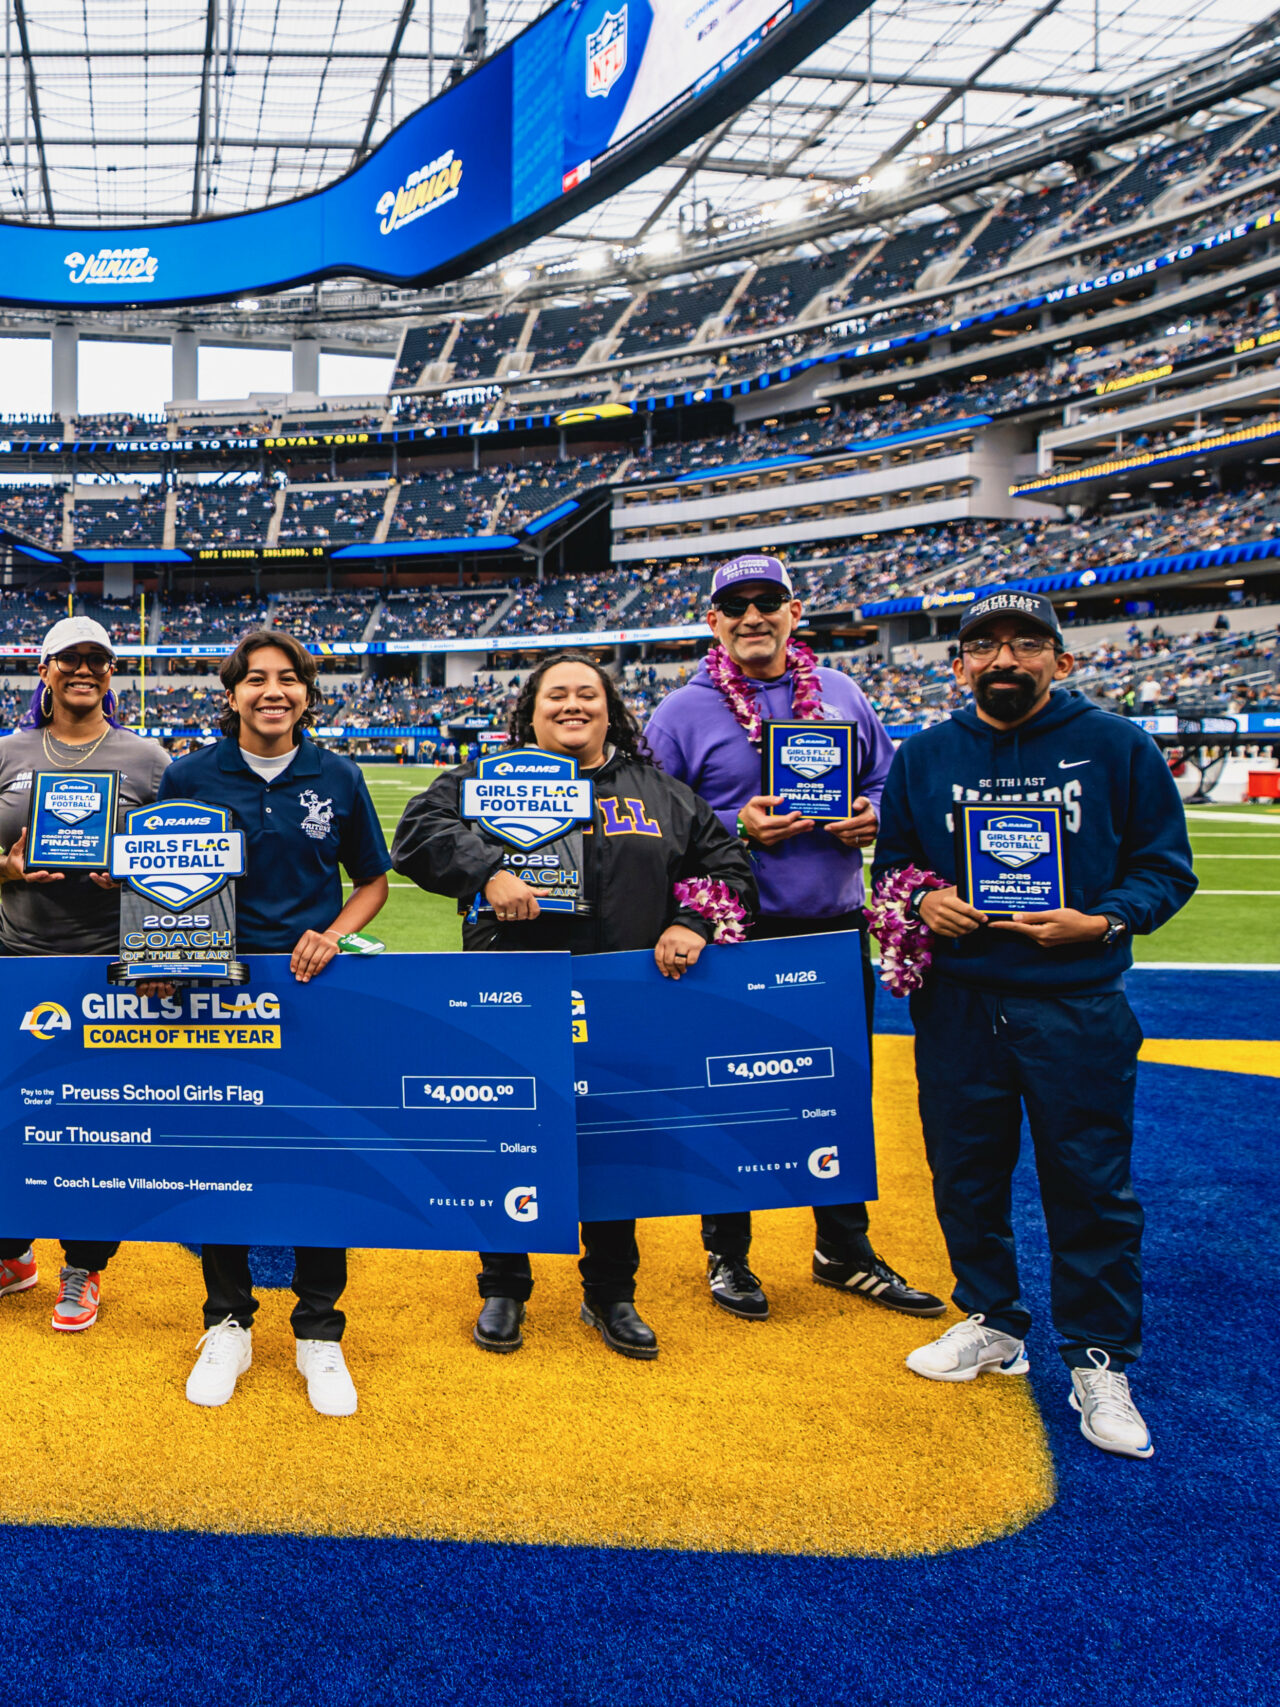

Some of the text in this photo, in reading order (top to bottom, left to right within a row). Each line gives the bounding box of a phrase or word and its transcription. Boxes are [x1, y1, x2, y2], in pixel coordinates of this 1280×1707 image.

[590, 44, 623, 86] NFL
[69, 254, 158, 284] Junior
[1046, 224, 1248, 303] WELCOME TO THE
[115, 433, 369, 452] WELCOME TO THE ROYAL TOUR
[513, 765, 561, 773] RAMS
[476, 785, 579, 798] GIRLS FLAG
[780, 793, 841, 801] FINALIST
[480, 799, 574, 812] FOOTBALL
[164, 817, 212, 826] RAMS
[41, 839, 99, 847] FINALIST
[987, 833, 1016, 841] GIRLS
[124, 838, 230, 854] GIRLS FLAG
[989, 841, 1040, 849] FOOTBALL
[129, 854, 225, 869] FOOTBALL
[980, 885, 1051, 894] FINALIST
[143, 914, 210, 929] 2025
[124, 931, 231, 948] COACH
[122, 950, 230, 961] OF THE YEAR
[747, 970, 818, 991] Date 1/4/26
[82, 993, 281, 1020] GIRLS FLAG
[449, 991, 523, 1008] Date 1/4/26
[89, 1029, 274, 1044] COACH OF THE YEAR
[21, 1088, 55, 1098] Pay to the
[62, 1084, 264, 1105] Preuss School Girls Flag
[802, 1108, 837, 1119] Dollars
[24, 1126, 152, 1144] Four Thousand
[500, 1142, 538, 1153] Dollars
[738, 1163, 780, 1173] FUELED
[808, 1145, 840, 1179] G
[53, 1176, 90, 1188] Coach
[92, 1177, 126, 1189] Leslie
[127, 1178, 253, 1192] Villalobos-Hernandez
[430, 1198, 494, 1207] FUELED BY
[504, 1186, 539, 1222] G
